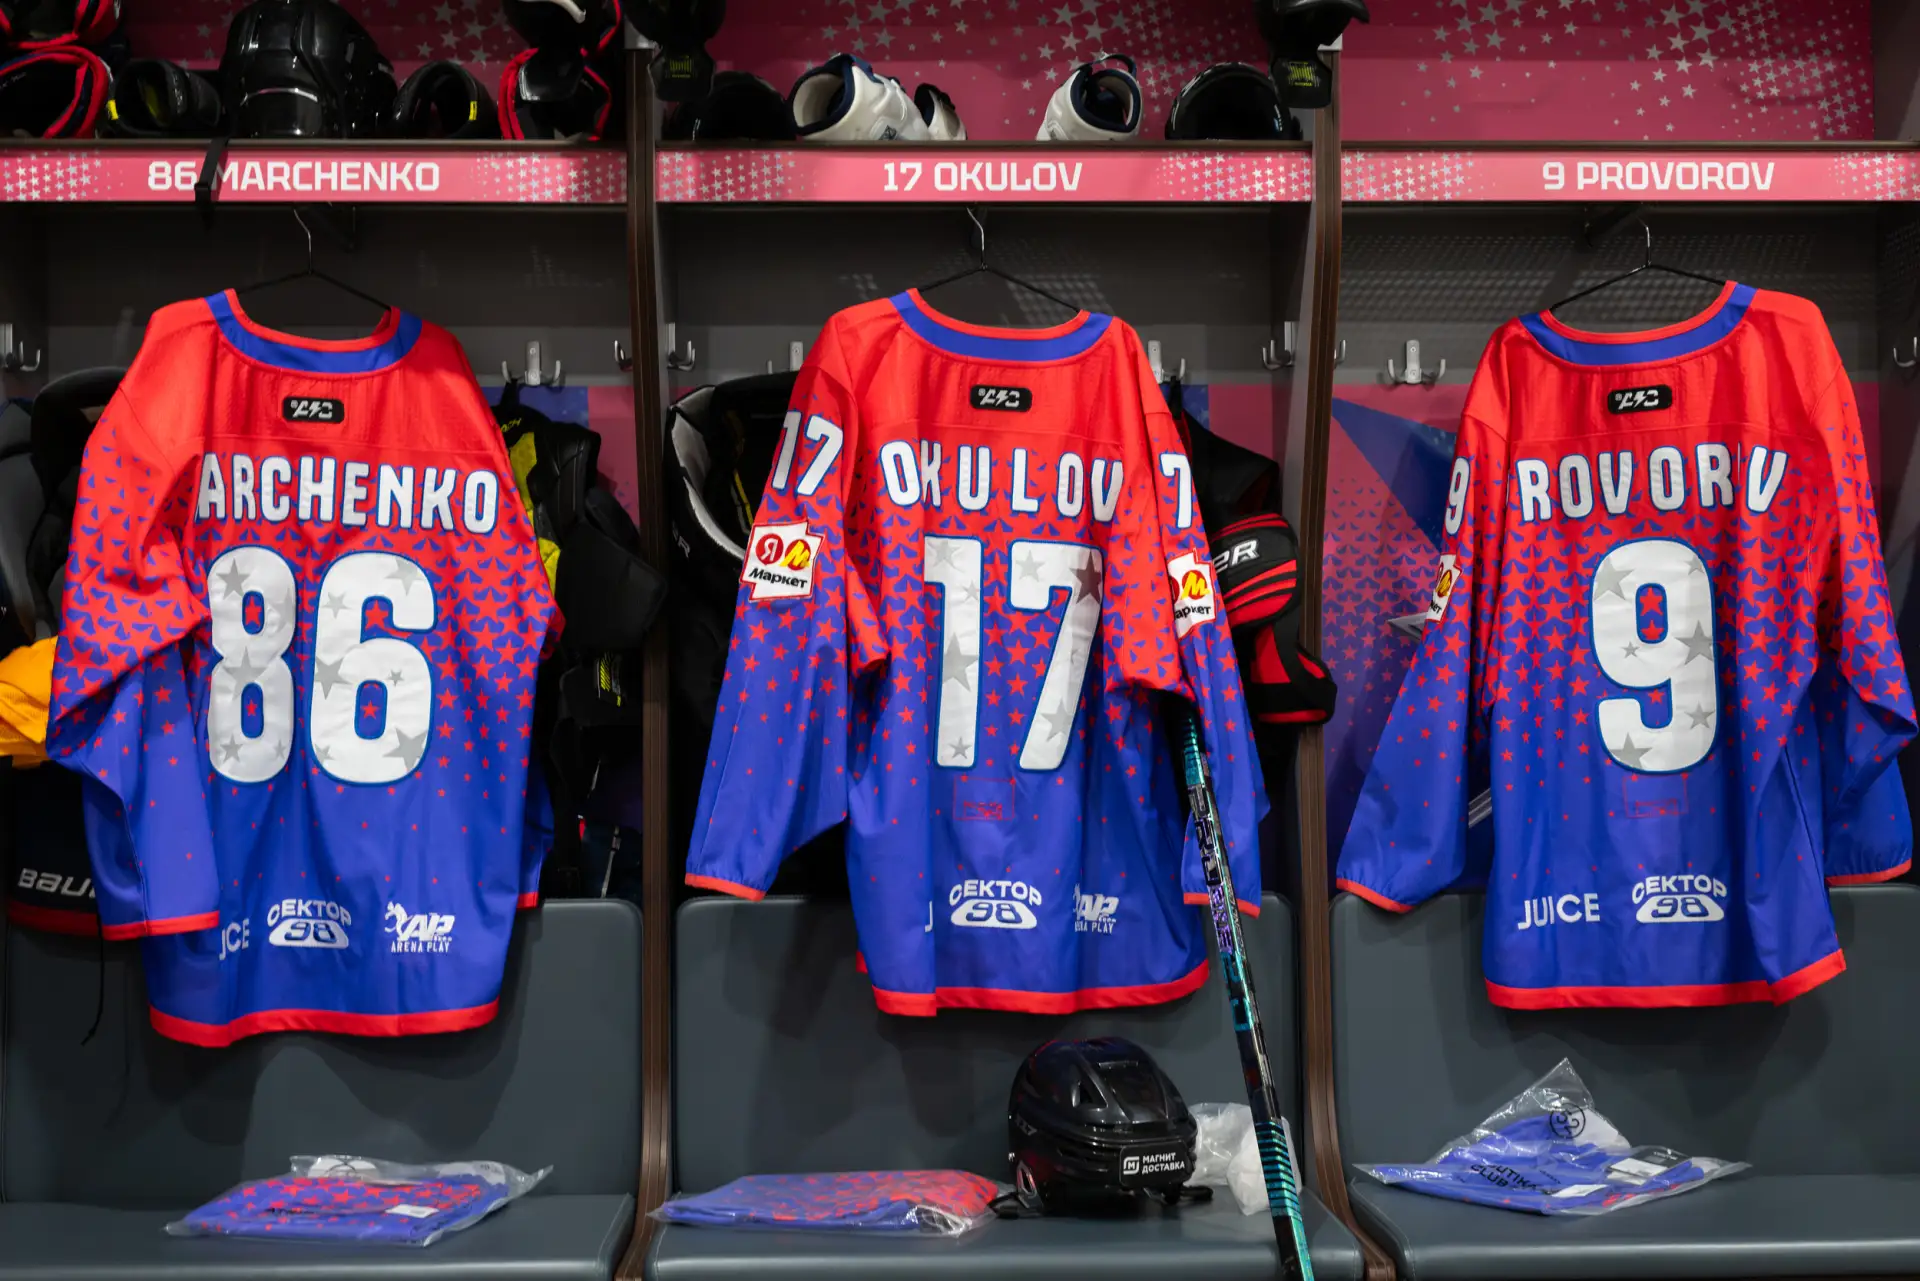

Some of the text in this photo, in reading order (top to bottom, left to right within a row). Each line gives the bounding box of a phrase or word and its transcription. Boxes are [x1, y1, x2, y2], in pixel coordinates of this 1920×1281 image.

[147, 160, 440, 191] 86 MARCHENKO
[883, 161, 1084, 192] 17 OKULOV
[1542, 160, 1775, 192] 9 PROVOROV
[771, 410, 844, 496] 17
[196, 451, 499, 535] ARCHENKO
[879, 438, 1125, 523] OKULOV
[1158, 452, 1193, 530] 7
[1444, 456, 1471, 536] 9
[1514, 441, 1789, 523] ROVORV
[748, 567, 808, 589] Маркет
[1174, 605, 1212, 619] аркет
[206, 544, 438, 785] 86
[923, 535, 1104, 772] 17
[1591, 537, 1718, 774] 9
[1517, 892, 1601, 930] JUICE
[218, 917, 250, 961] JCE
[390, 940, 450, 953] ARENA PLAY
[1141, 1161, 1186, 1176] ДОСТАВКА
[1142, 1152, 1177, 1165] МАГНИТ
